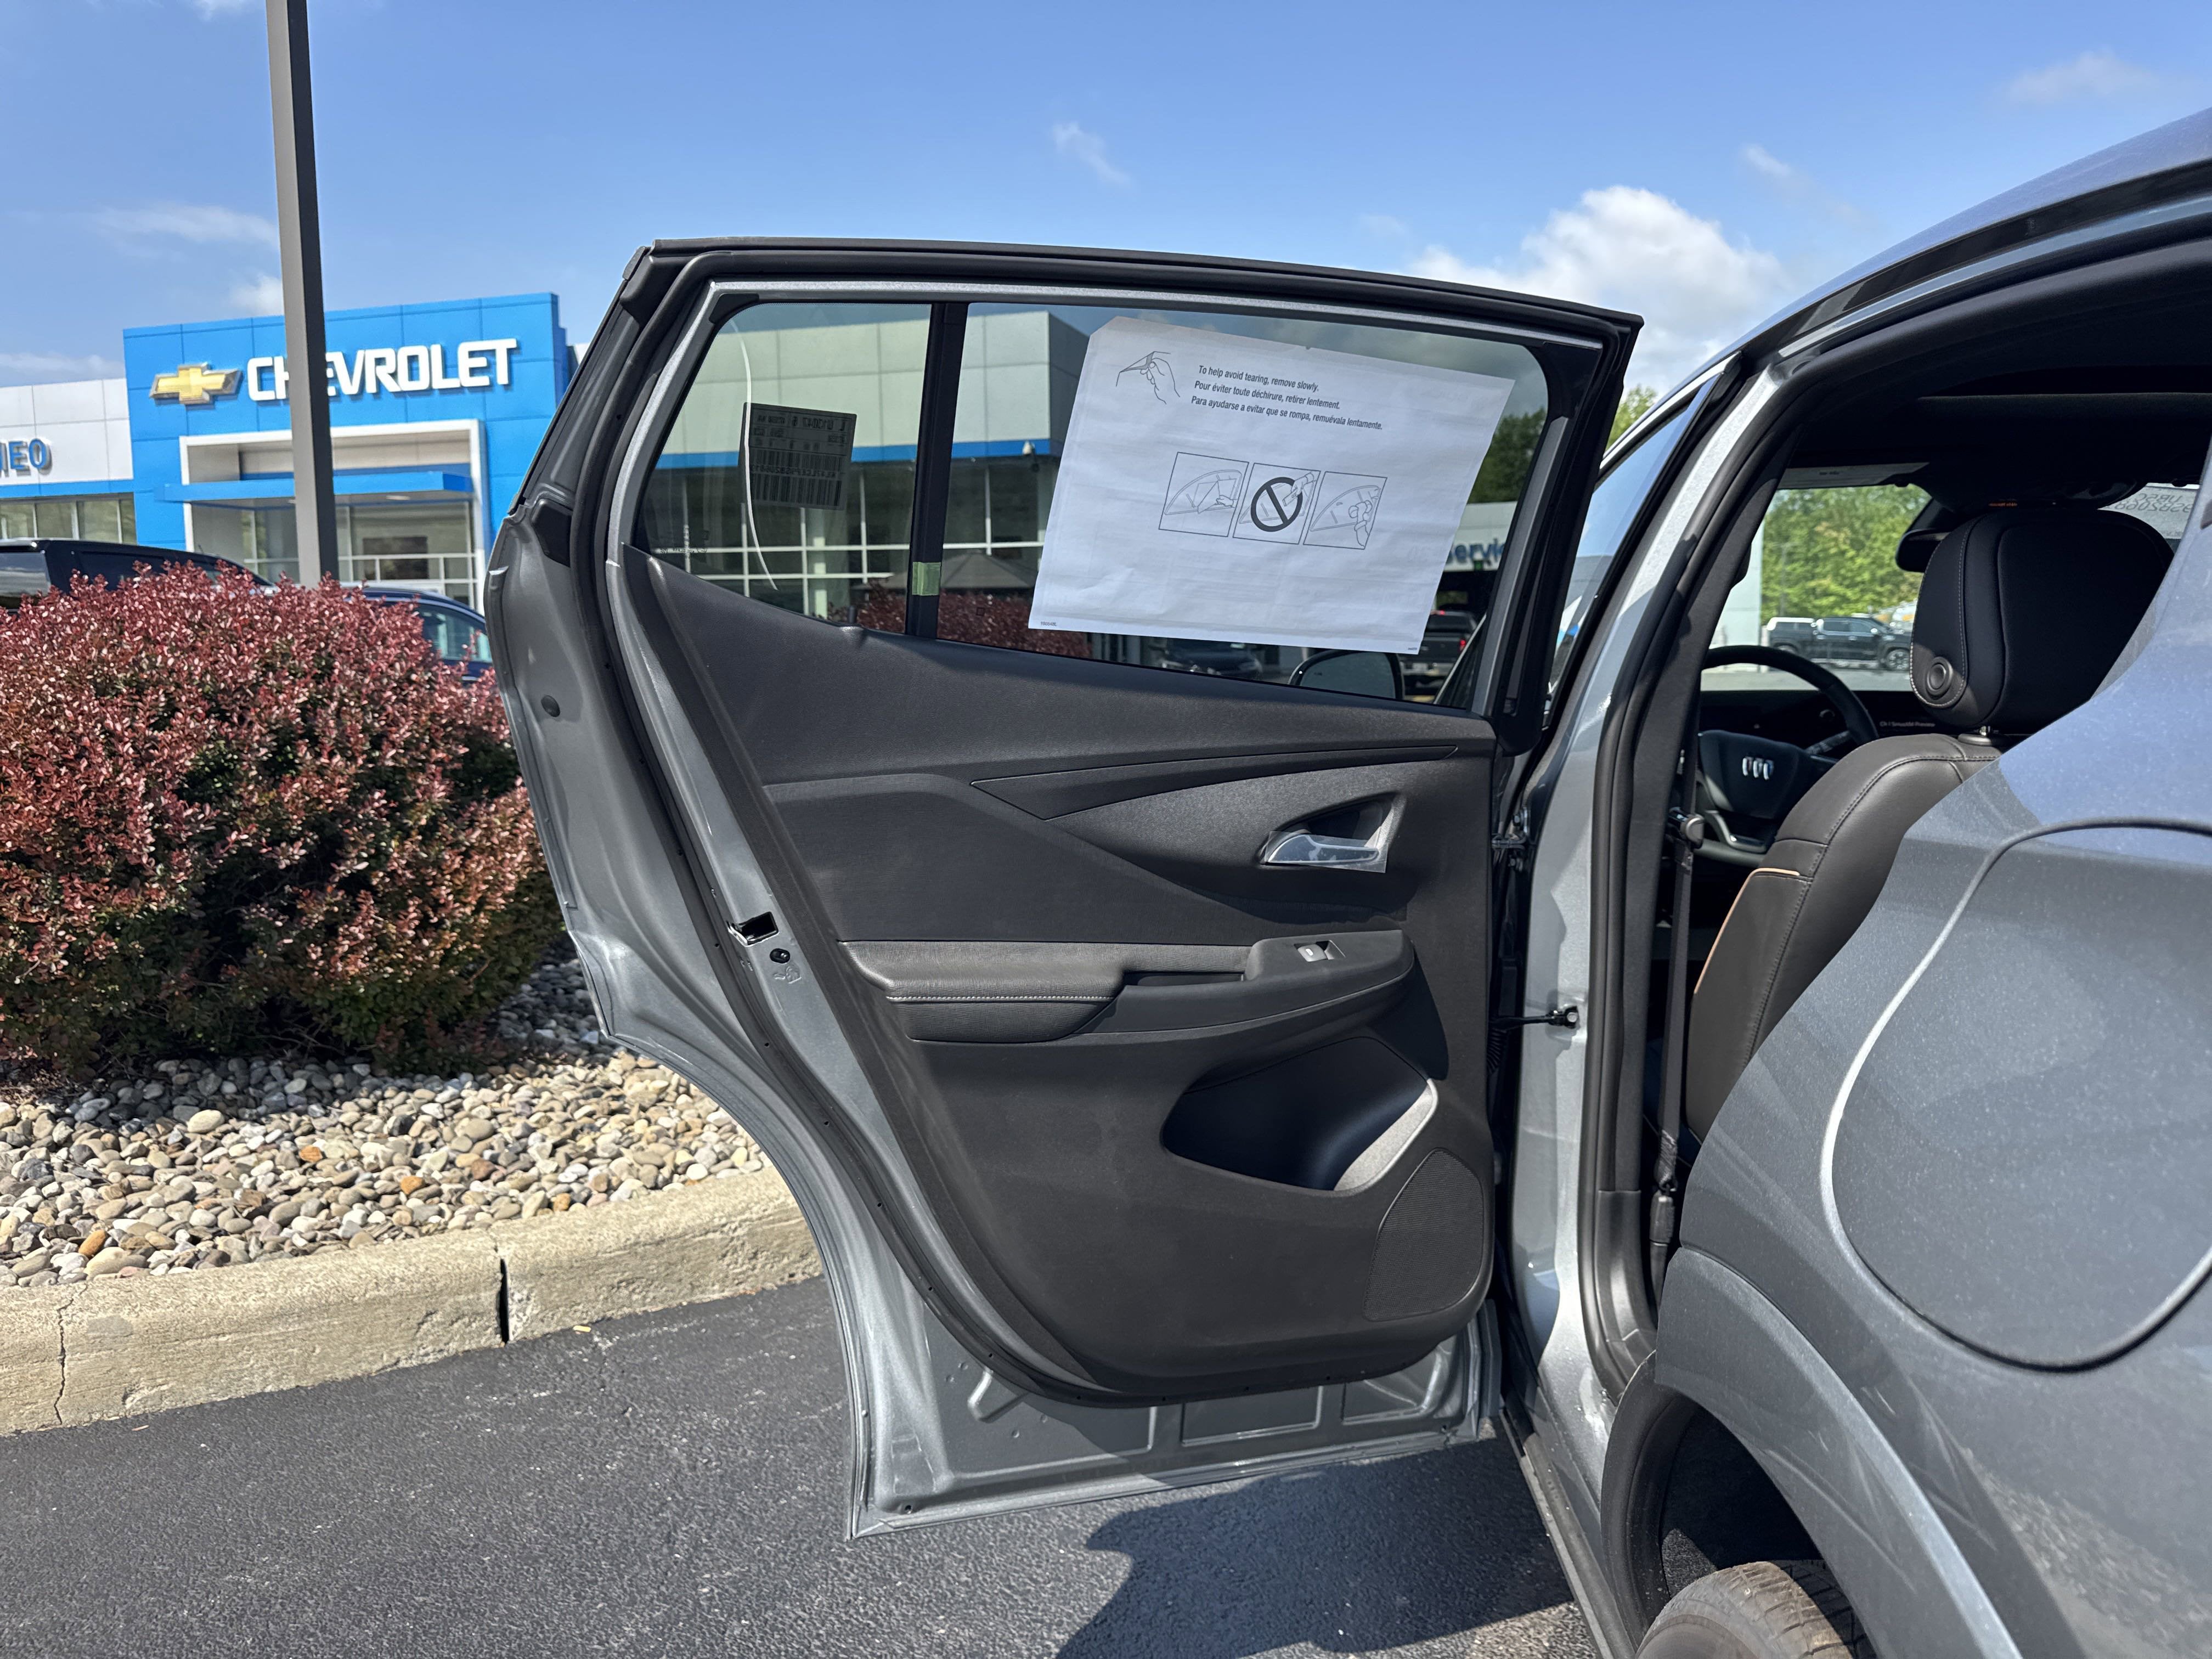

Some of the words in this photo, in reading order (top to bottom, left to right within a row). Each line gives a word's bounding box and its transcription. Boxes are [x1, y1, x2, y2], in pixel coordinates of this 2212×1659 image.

[1199, 365, 1207, 374] To
[1208, 366, 1223, 378] help
[1224, 371, 1244, 380] avoid
[1245, 373, 1269, 385] tearing,
[1271, 377, 1296, 388] remove
[1297, 381, 1319, 392] slowly.
[1194, 380, 1211, 390] Pour
[1212, 383, 1232, 394] éviter
[1233, 387, 1250, 396] toute
[1251, 389, 1283, 402] déchirure,
[1285, 394, 1307, 404] retirer
[1307, 397, 1340, 409] lentement.
[1191, 396, 1207, 405] Para
[1208, 400, 1239, 410] ayudarse
[1246, 405, 1266, 413] evitar
[1266, 408, 1279, 416] que
[1289, 411, 1311, 421] rompa,
[1312, 415, 1346, 425] remuévala
[1347, 418, 1383, 430] lentamente.
[0, 438, 49, 473] EO
